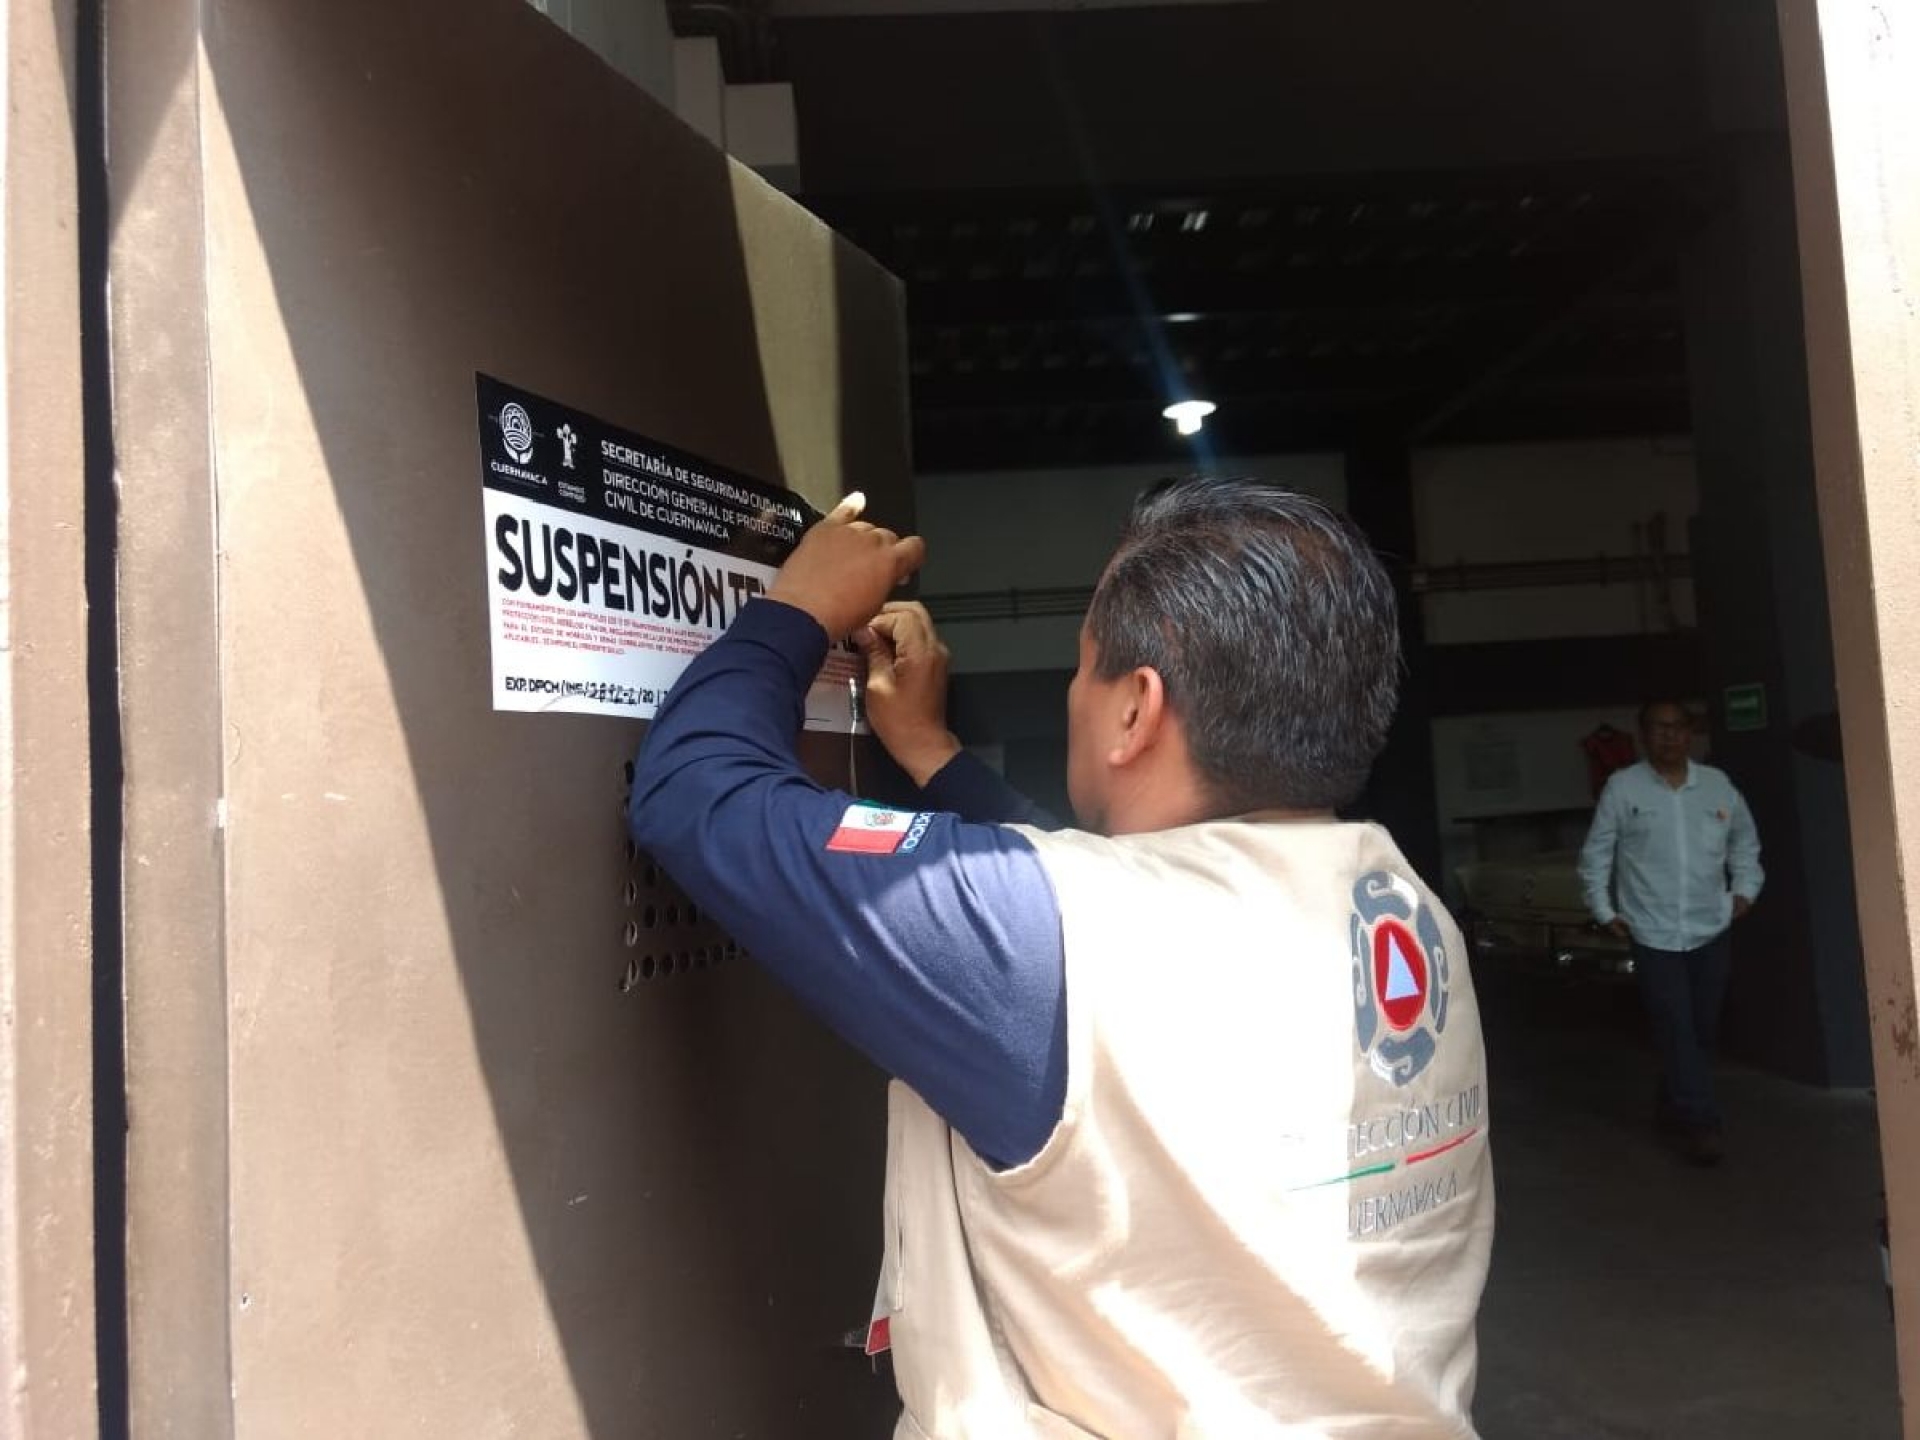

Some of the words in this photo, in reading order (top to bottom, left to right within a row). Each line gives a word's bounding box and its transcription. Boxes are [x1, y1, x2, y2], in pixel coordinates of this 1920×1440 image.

[490, 459, 548, 485] CUERNAVACA
[601, 440, 674, 479] SECRETARÍA
[675, 466, 689, 484] DE
[690, 472, 750, 505] SEGURIDAD
[750, 493, 803, 525] CIUDADANA
[602, 469, 670, 505] DIRECCIÓN
[671, 490, 720, 521] GENERAL
[722, 508, 736, 525] DE
[604, 490, 638, 515] CIVIL
[639, 501, 655, 519] DE
[656, 506, 730, 543] CUERNAVACA
[495, 513, 726, 630] SUSPENSIÓN
[505, 676, 527, 692] EXP.
[1347, 1169, 1457, 1238] UERNAVACA
